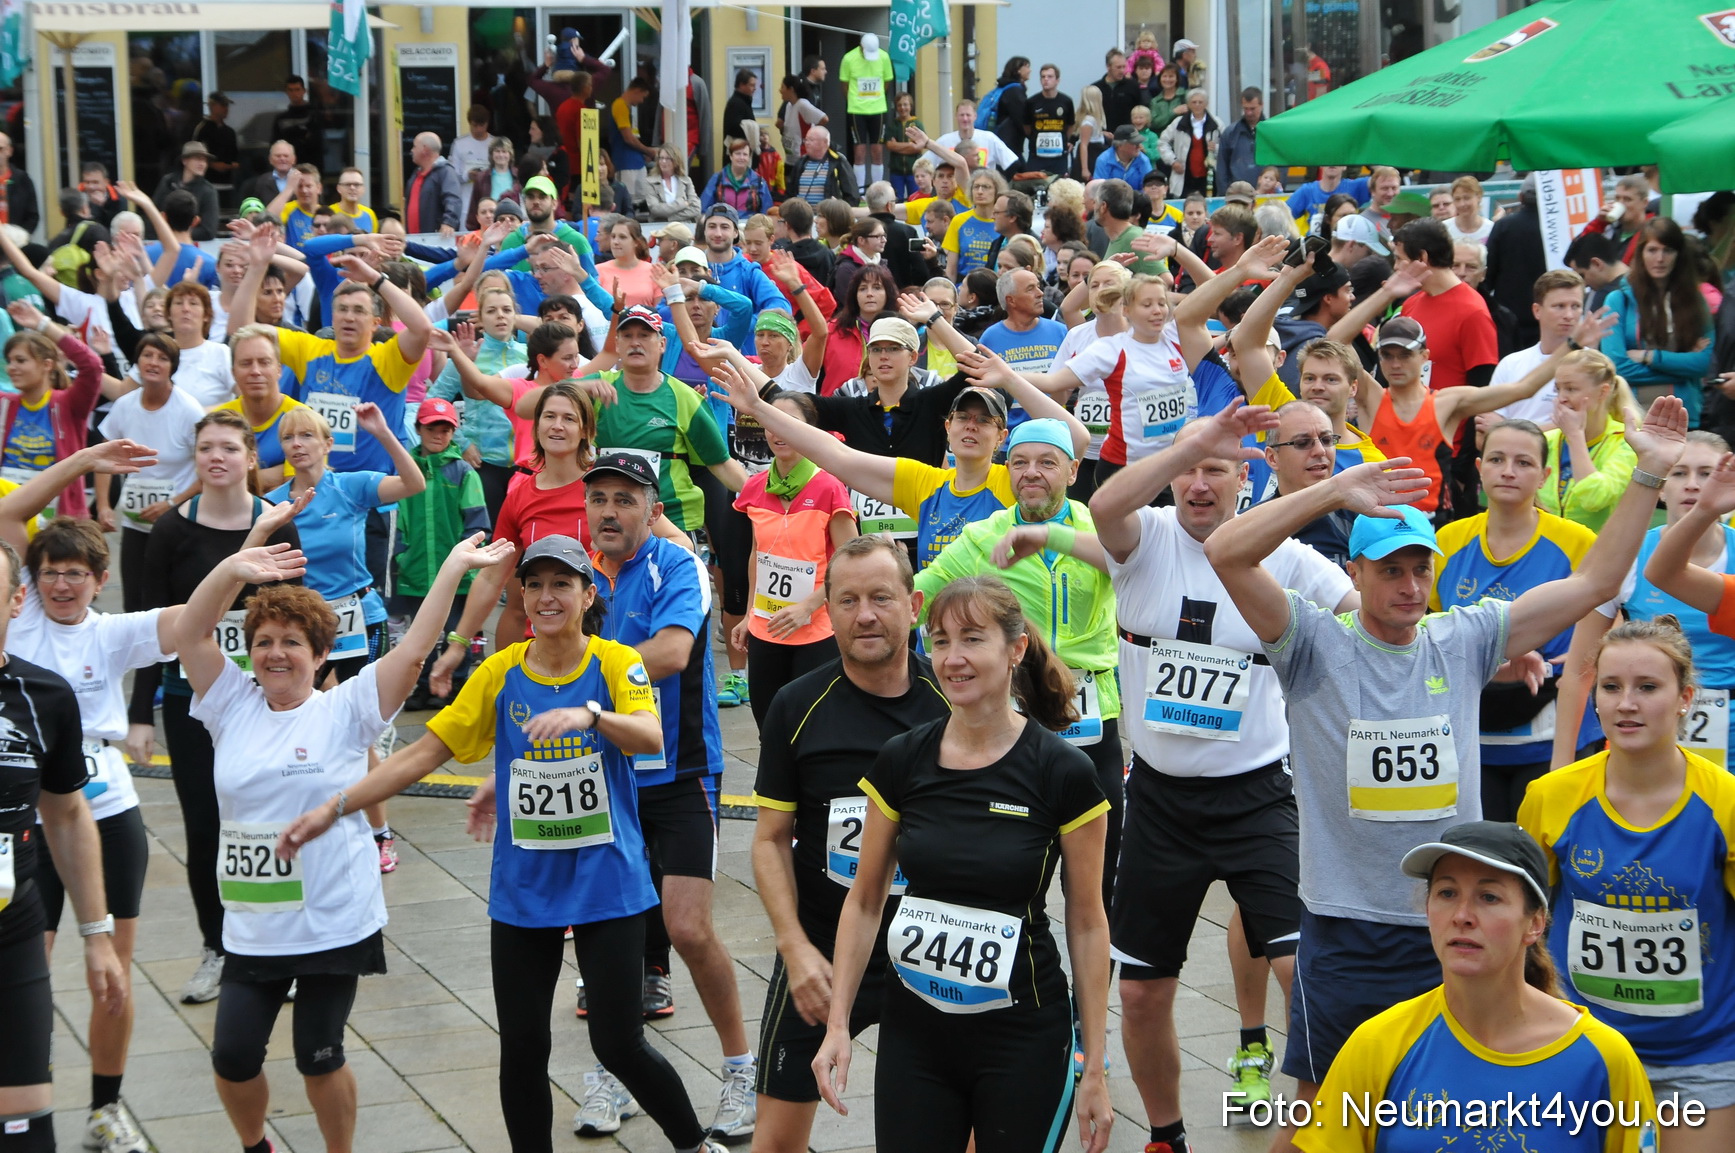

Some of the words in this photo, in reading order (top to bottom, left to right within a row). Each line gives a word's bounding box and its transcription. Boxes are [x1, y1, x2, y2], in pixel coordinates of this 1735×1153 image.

[862, 82, 877, 91] 317
[583, 113, 597, 130] Block
[1039, 138, 1061, 148] 2910
[585, 138, 596, 184] A
[1005, 345, 1057, 356] NEUMARKTER
[1005, 351, 1050, 362] STADTLAUF
[1146, 396, 1186, 424] 2895
[1162, 425, 1178, 434] Julia
[126, 491, 170, 510] 5107
[878, 522, 895, 531] Bea
[758, 557, 772, 568] PARTL
[773, 562, 804, 574] Neumarkt
[768, 571, 793, 598] 26
[1152, 647, 1185, 660] PARTL
[1187, 651, 1235, 667] Neumarkt
[1155, 662, 1241, 705] 2077
[1162, 705, 1223, 730] Wolfgang
[1350, 729, 1388, 741] PARTL
[1390, 727, 1440, 740] Neumarkt
[1372, 742, 1440, 783] 653
[512, 768, 537, 779] PARTL
[538, 766, 586, 780] Neumarkt
[518, 778, 599, 816] 5218
[221, 829, 240, 839] PARTL
[240, 831, 283, 841] Neumark
[537, 824, 583, 838] Sabine
[1577, 857, 1596, 867] Jahre
[1583, 849, 1592, 857] 15
[899, 907, 938, 924] PARTL
[939, 910, 997, 935] Neumarkt
[1575, 910, 1610, 930] PARTL
[1612, 919, 1674, 934] Neumarkt
[900, 925, 1002, 984] 2448
[1581, 930, 1688, 976] 5133
[929, 980, 964, 1002] Ruth
[1613, 983, 1656, 1001] Anna
